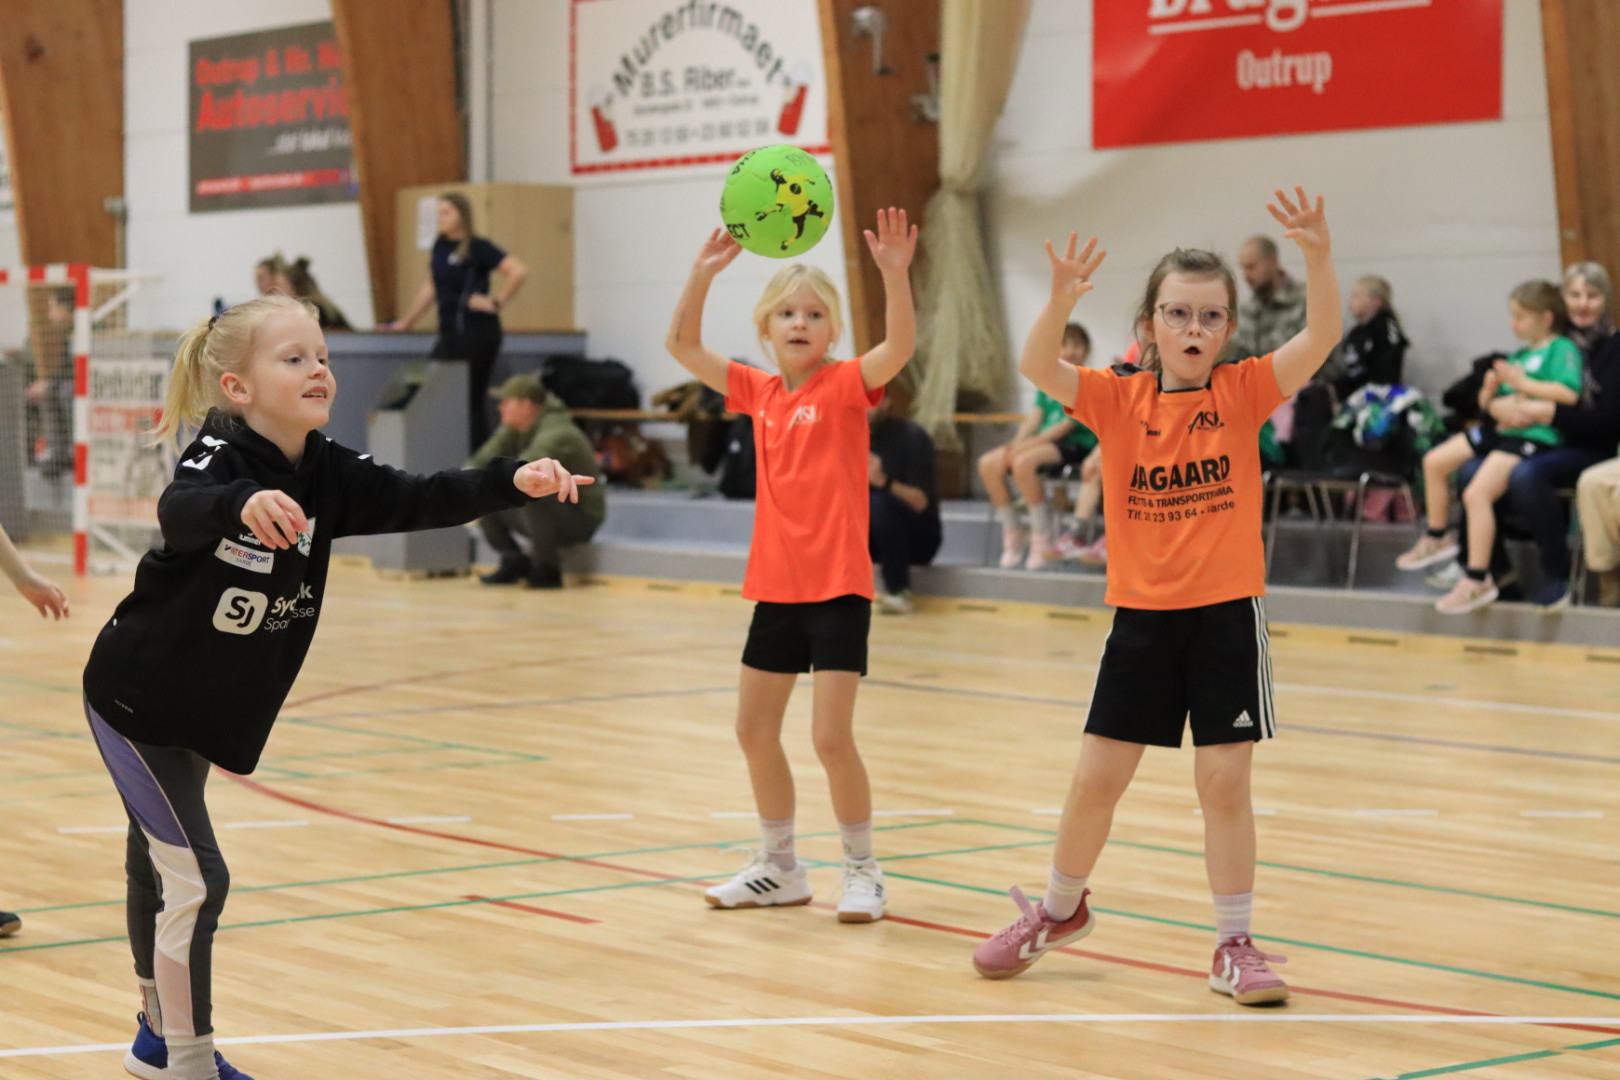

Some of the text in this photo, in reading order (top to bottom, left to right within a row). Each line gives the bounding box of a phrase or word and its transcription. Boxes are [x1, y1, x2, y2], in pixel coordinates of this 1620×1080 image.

[613, 0, 784, 97] Murerfirmaet
[684, 65, 736, 92] Riber
[1236, 48, 1332, 93] Outrup
[1167, 509, 1183, 522] 93
[1184, 506, 1198, 519] 64
